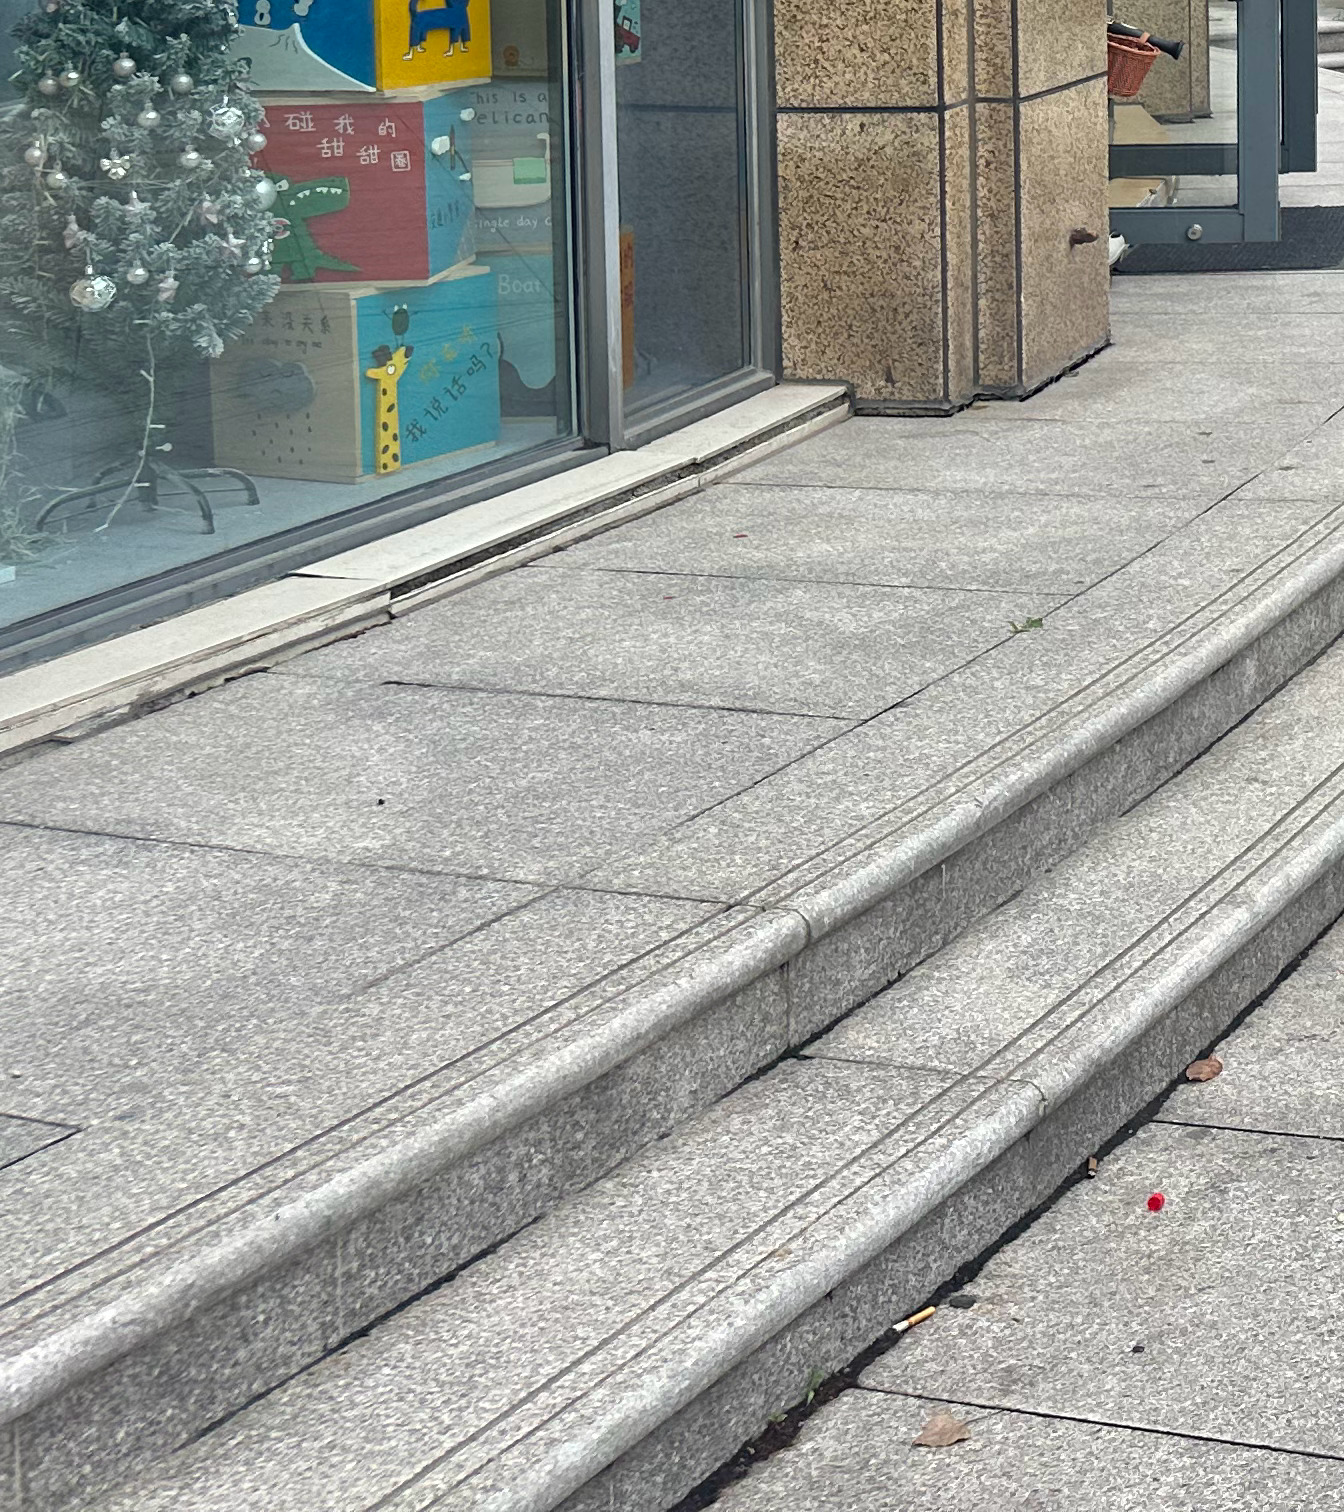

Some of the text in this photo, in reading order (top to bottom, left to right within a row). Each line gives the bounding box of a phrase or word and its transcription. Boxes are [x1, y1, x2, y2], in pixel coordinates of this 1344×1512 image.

[537, 92, 547, 103] a
[315, 137, 411, 172] 甜甜圈
[516, 215, 538, 228] day
